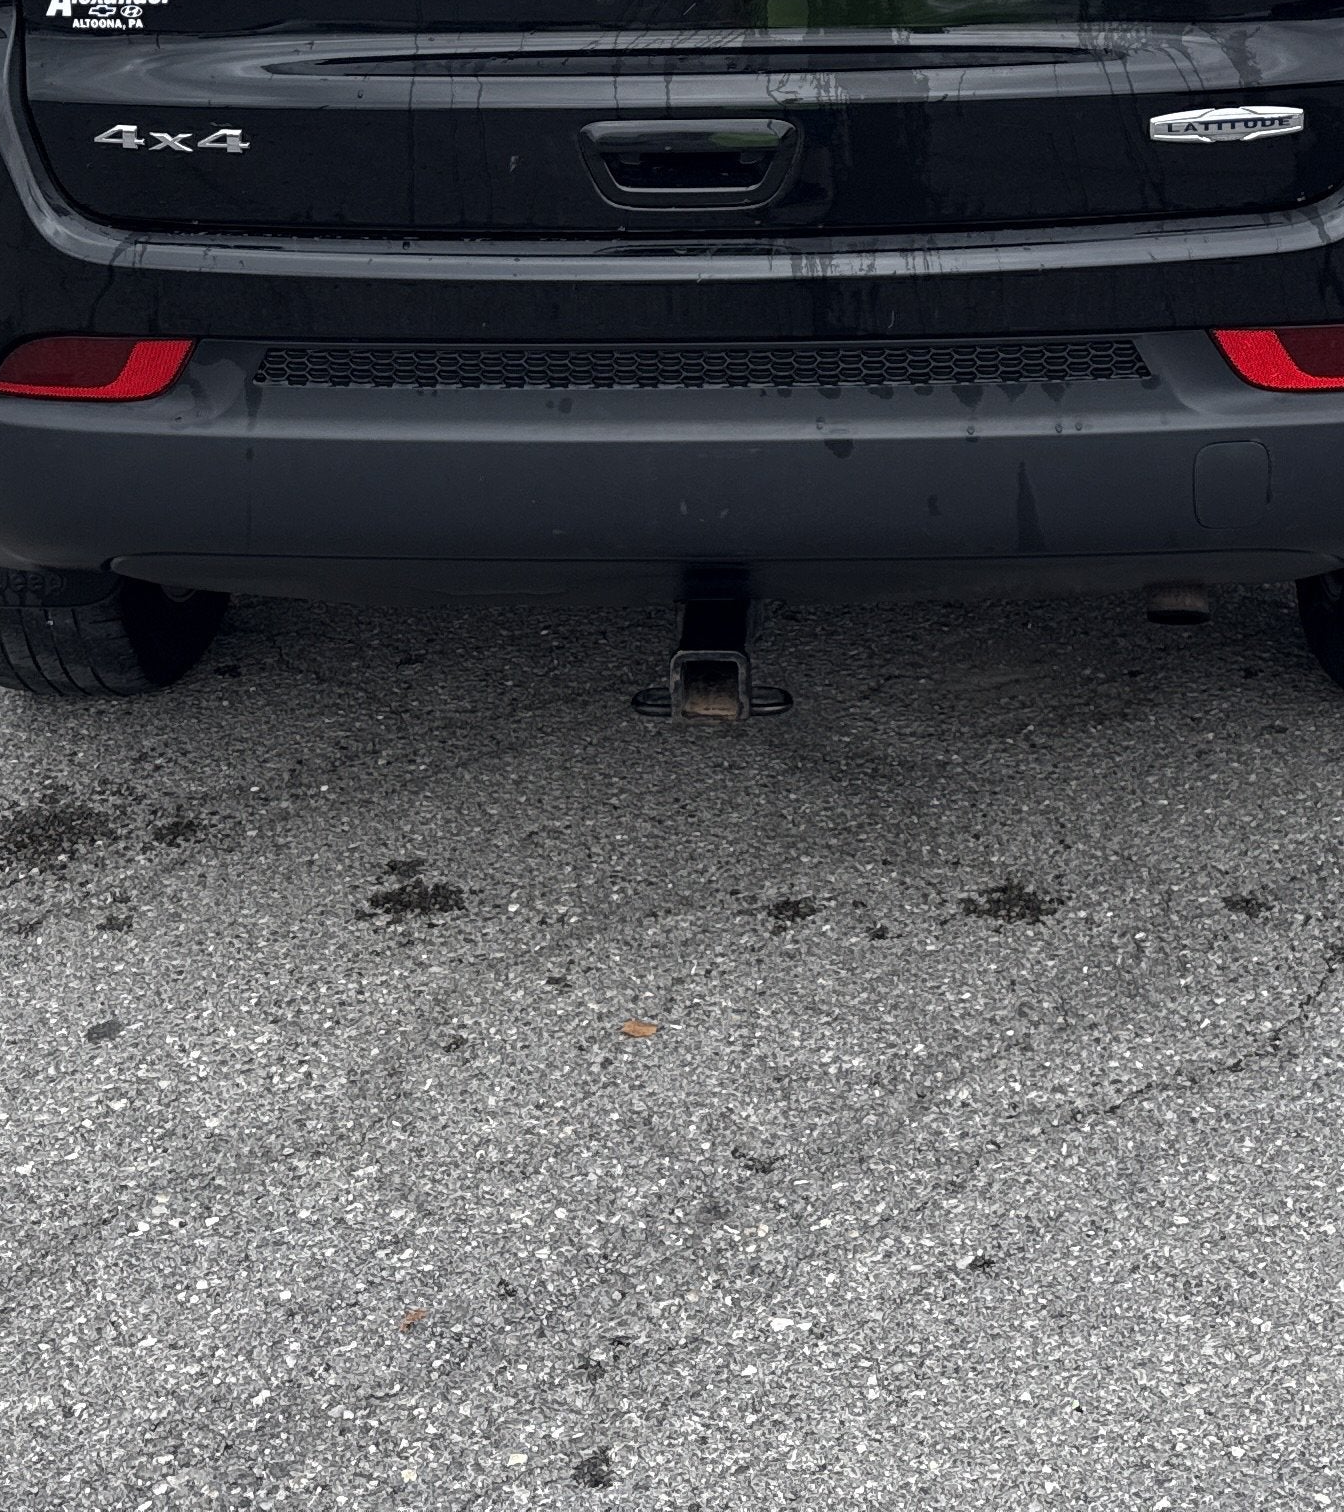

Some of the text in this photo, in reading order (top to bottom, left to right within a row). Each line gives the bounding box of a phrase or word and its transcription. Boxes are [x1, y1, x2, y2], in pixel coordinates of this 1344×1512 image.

[72, 18, 144, 30] ALTOONA, PA
[1166, 115, 1293, 133] LATITUDE
